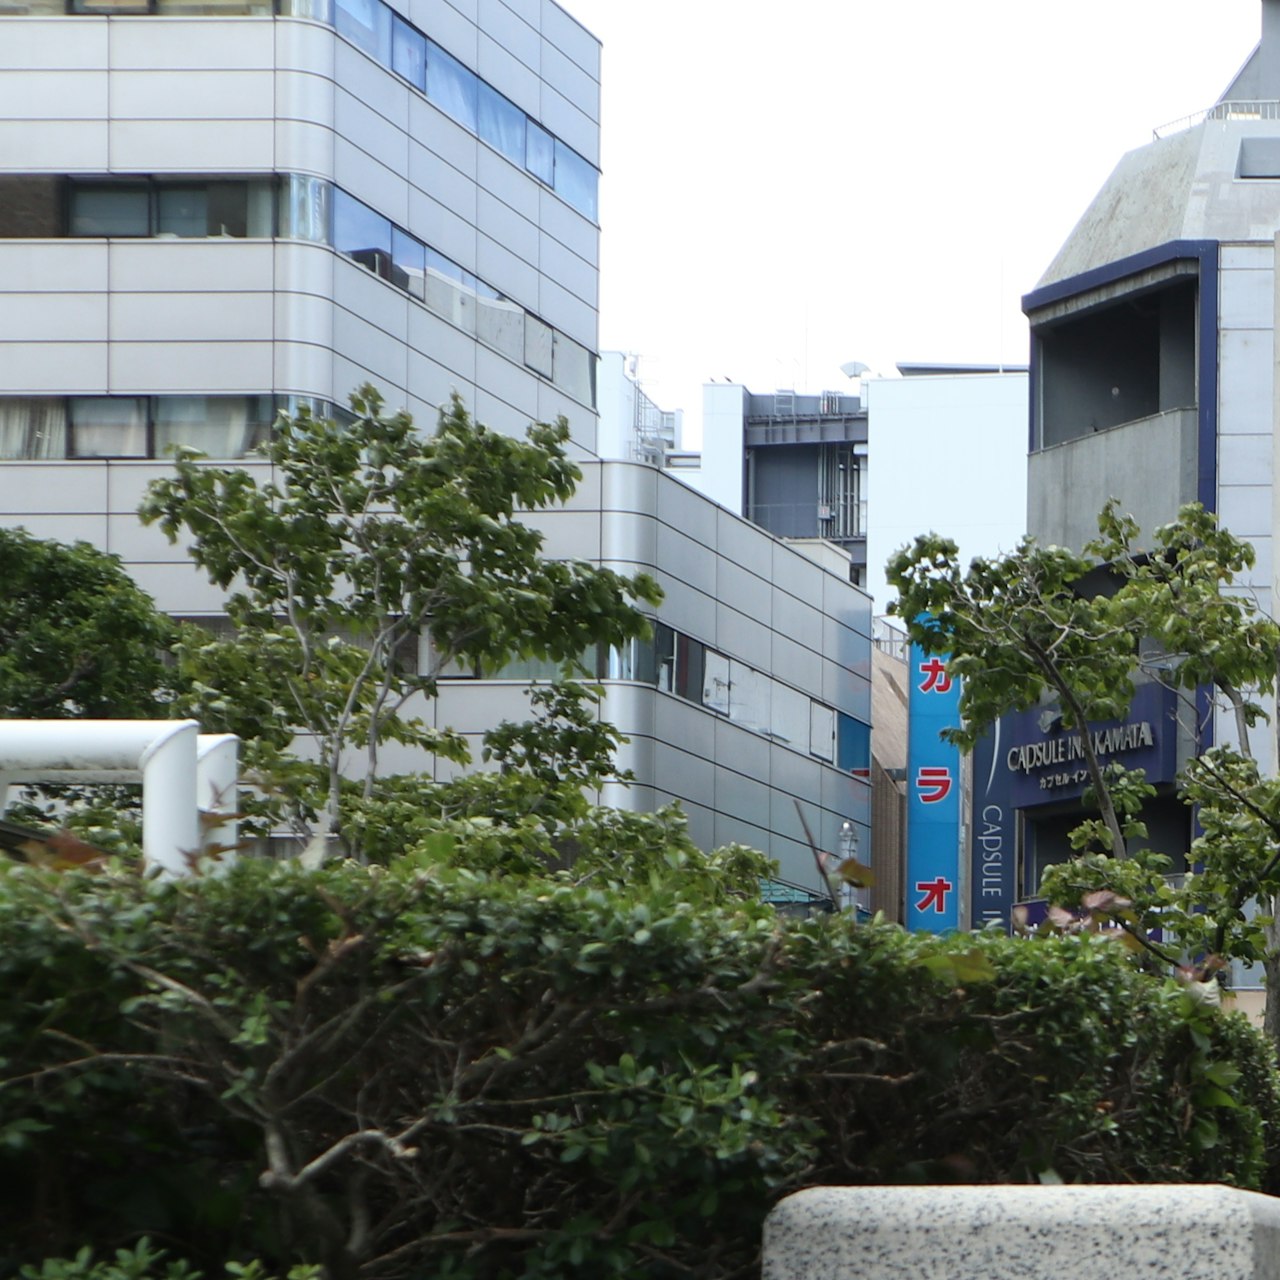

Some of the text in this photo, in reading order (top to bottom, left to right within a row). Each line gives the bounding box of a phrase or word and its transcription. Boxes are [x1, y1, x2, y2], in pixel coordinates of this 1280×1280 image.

[1007, 738, 1065, 774] CAPSULE
[1094, 721, 1153, 755] KAMATA
[977, 805, 1002, 897] CAPSULE
